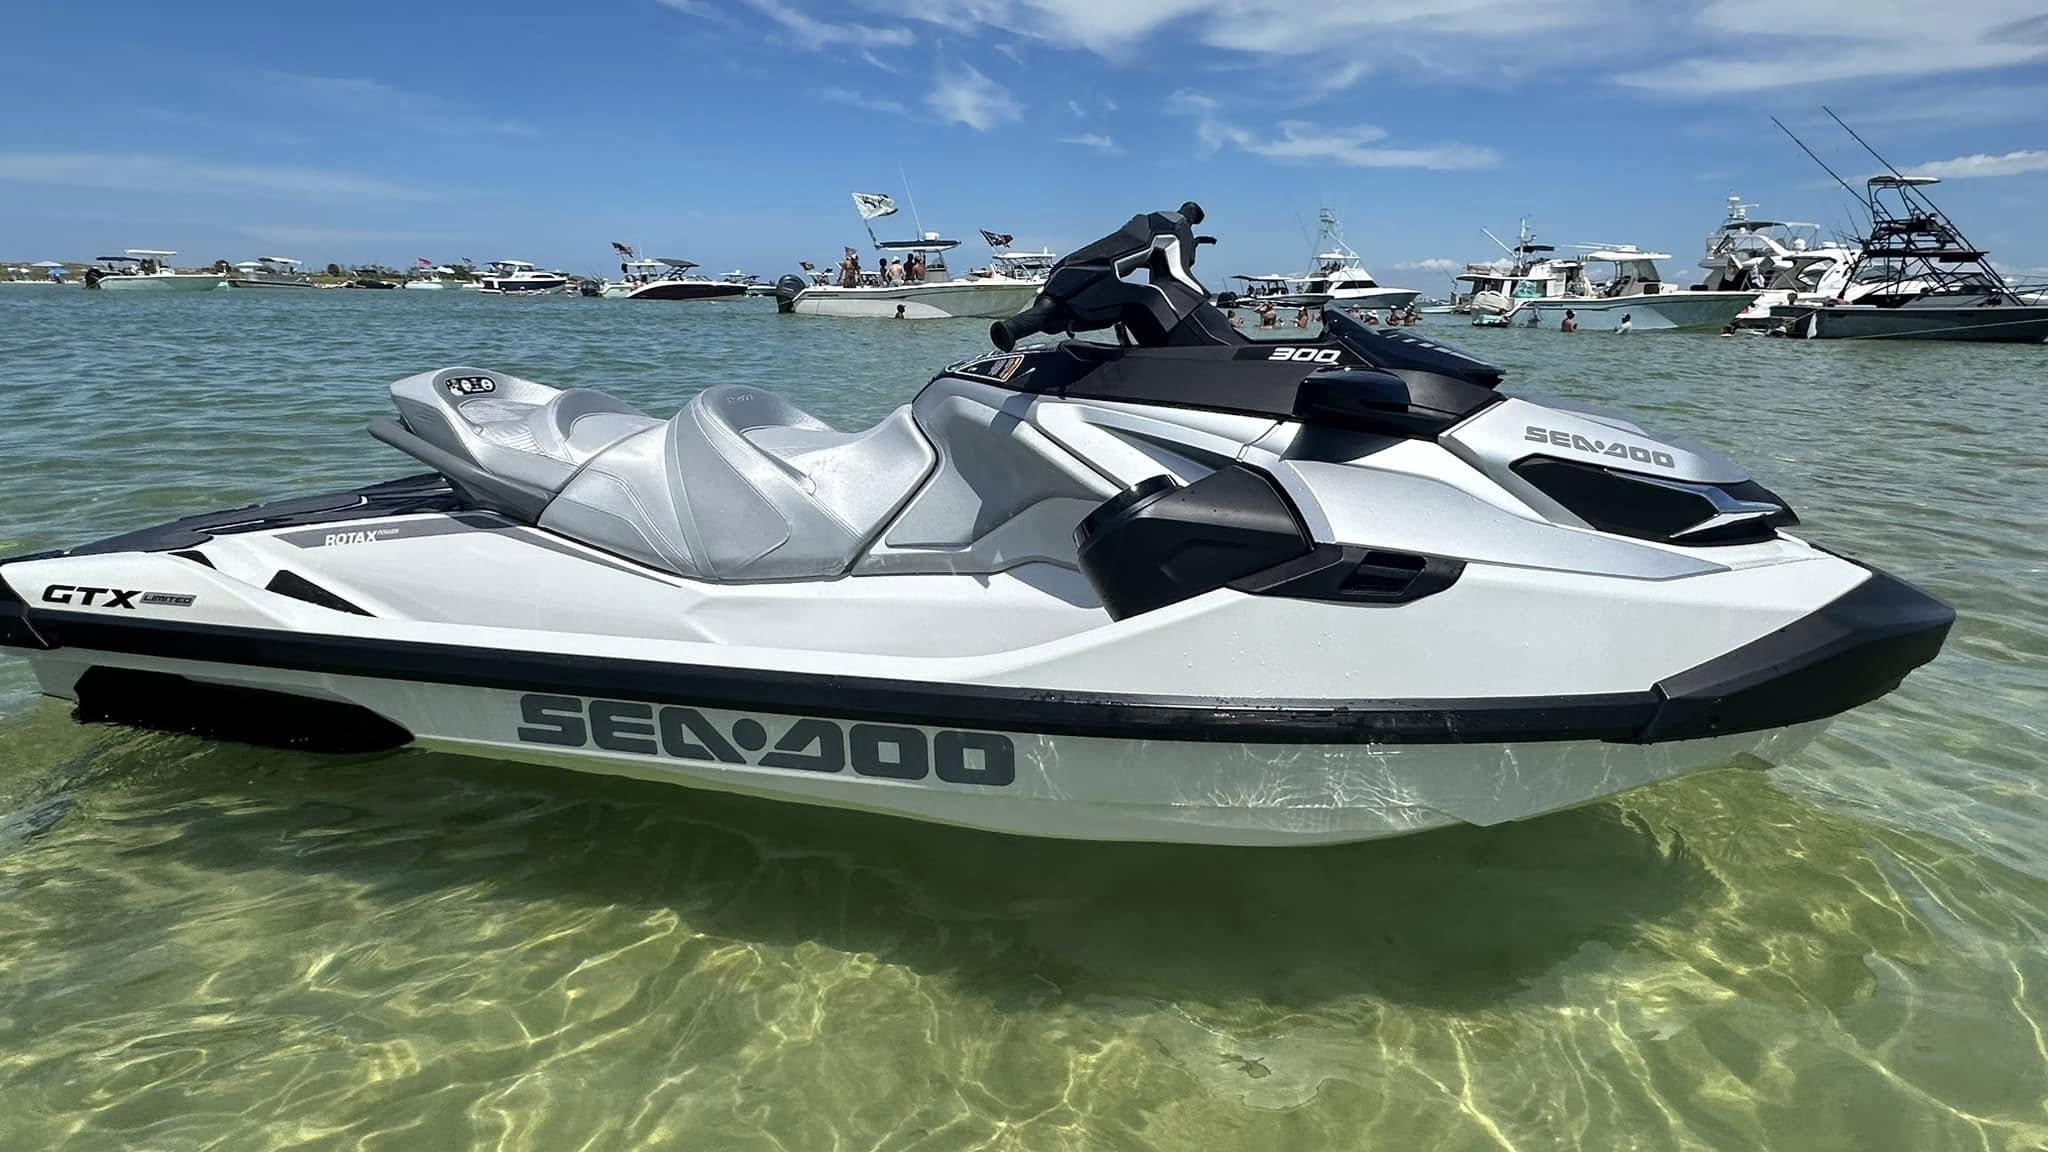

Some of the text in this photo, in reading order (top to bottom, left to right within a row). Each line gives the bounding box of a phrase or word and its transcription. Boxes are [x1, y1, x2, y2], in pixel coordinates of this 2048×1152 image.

[1268, 347, 1341, 363] 300
[325, 530, 377, 547] ROTAX
[42, 584, 194, 609] GTX LIMITED
